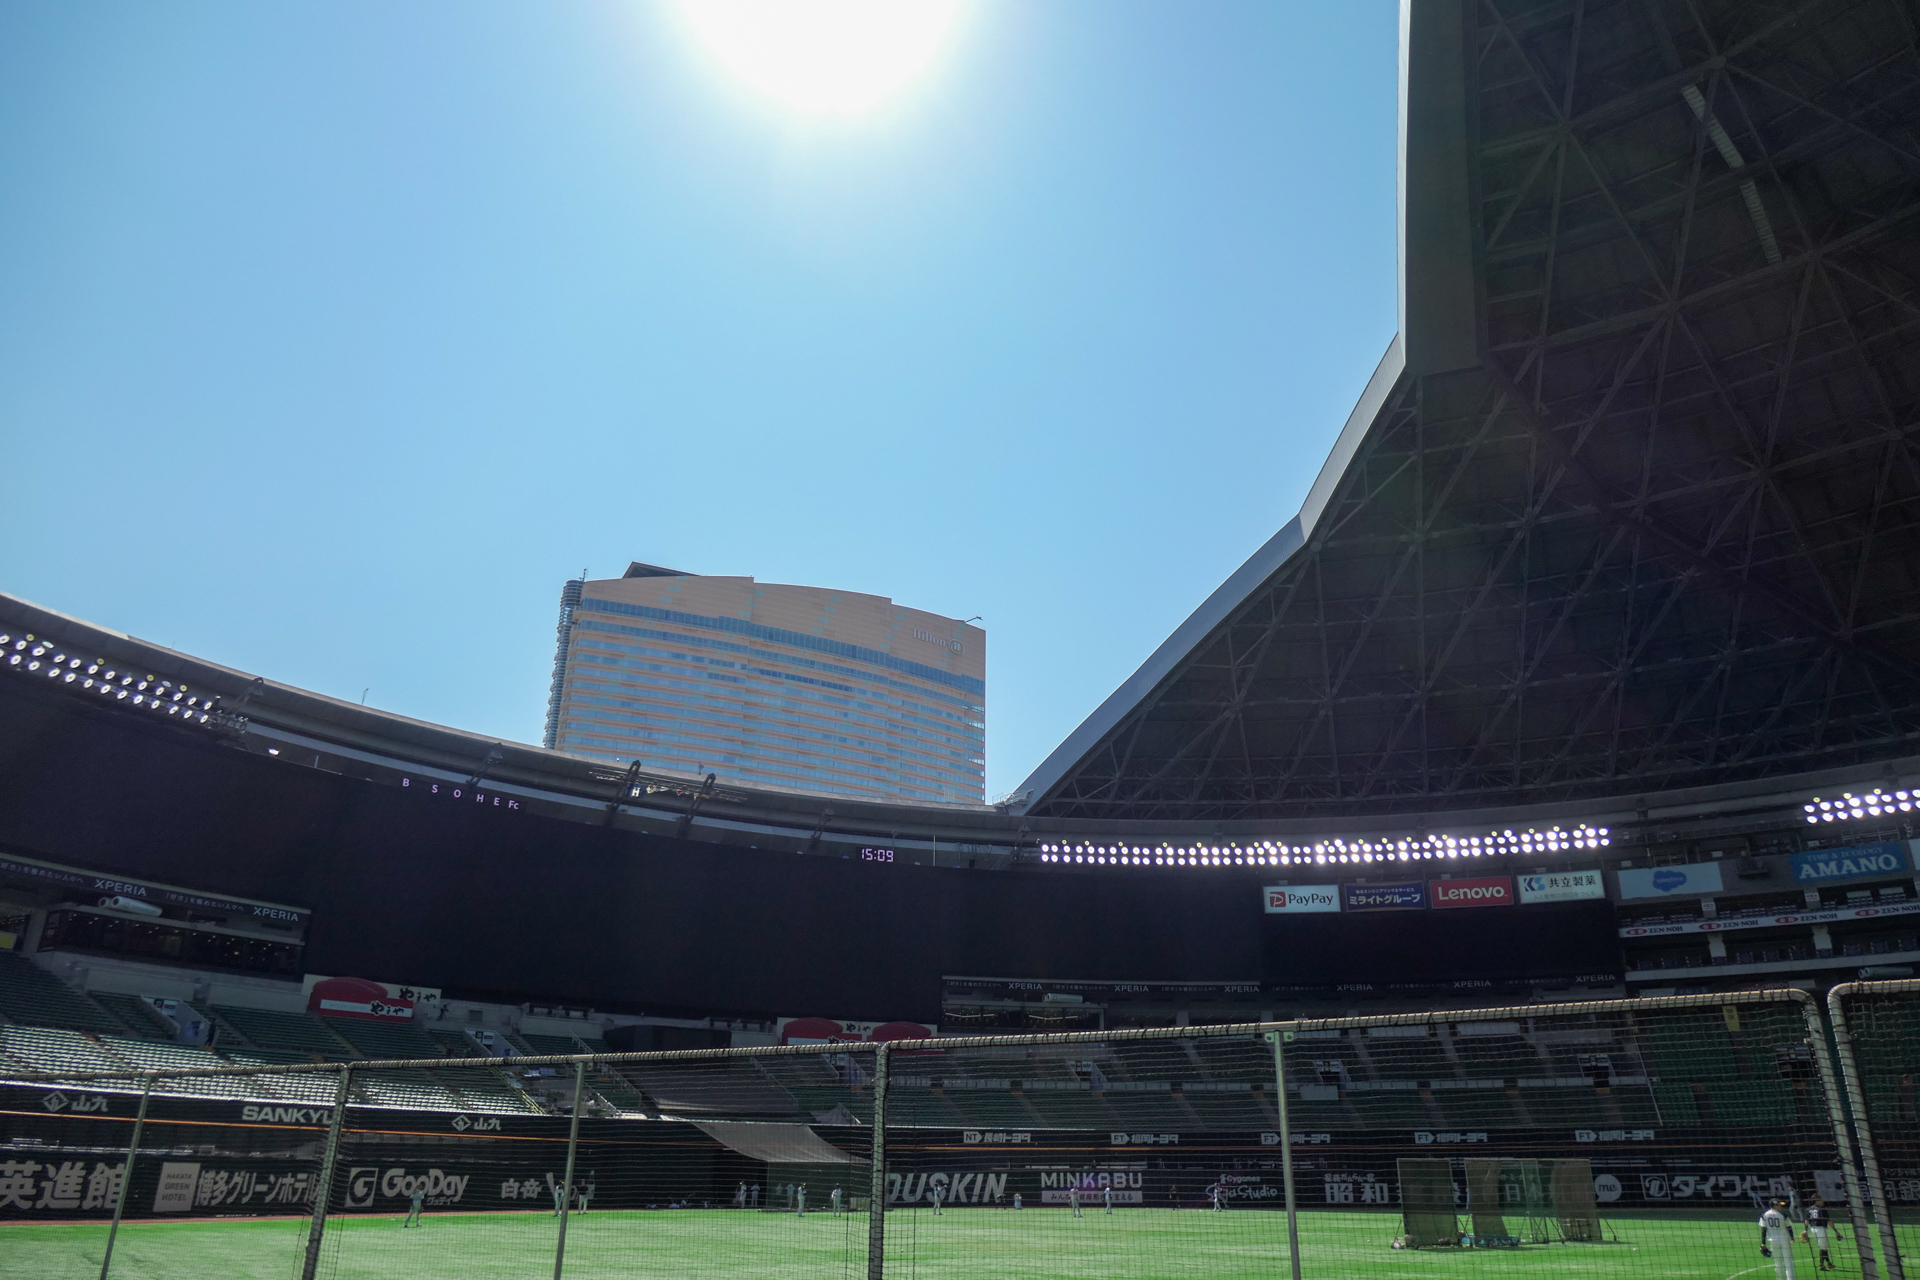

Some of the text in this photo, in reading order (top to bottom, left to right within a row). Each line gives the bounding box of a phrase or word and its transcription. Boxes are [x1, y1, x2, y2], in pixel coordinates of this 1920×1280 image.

[913, 628, 947, 648] Hilton
[402, 778, 410, 788] B
[431, 784, 438, 794] S
[476, 794, 484, 803] H
[493, 796, 500, 806] E
[861, 848, 894, 863] 15:09
[1806, 853, 1829, 862] TIME
[1841, 846, 1884, 858] ECOLOGY
[1799, 853, 1898, 880] AMANO
[94, 878, 147, 897] XPERIA
[1549, 875, 1596, 888] 共立製薬
[1288, 893, 1334, 906] PayPay
[1349, 893, 1421, 905] ミライトグループ
[1438, 886, 1505, 901] Lenovo
[253, 906, 299, 922] XPERIA
[1453, 980, 1492, 989] XPERIA
[1575, 973, 1616, 983] XPERIA
[1008, 982, 1043, 991] XPERIA
[1114, 984, 1149, 993] XPERIA
[1224, 985, 1260, 993] XPERIA
[1336, 983, 1373, 992] XPERIA
[71, 1094, 109, 1112] 山九
[473, 1117, 502, 1131] 山九
[983, 1132, 1032, 1143] 長崎トヨタ
[0, 1159, 125, 1210] 英進館
[164, 1182, 190, 1190] GREEN
[1041, 1172, 1142, 1188] MINKABU
[1672, 1175, 1793, 1198] ダイワ化成
[194, 1169, 319, 1207] 博多グリーンホテル
[1598, 1184, 1617, 1192] me
[161, 1193, 188, 1201] HOTEL
[1767, 1217, 1781, 1228] 00
